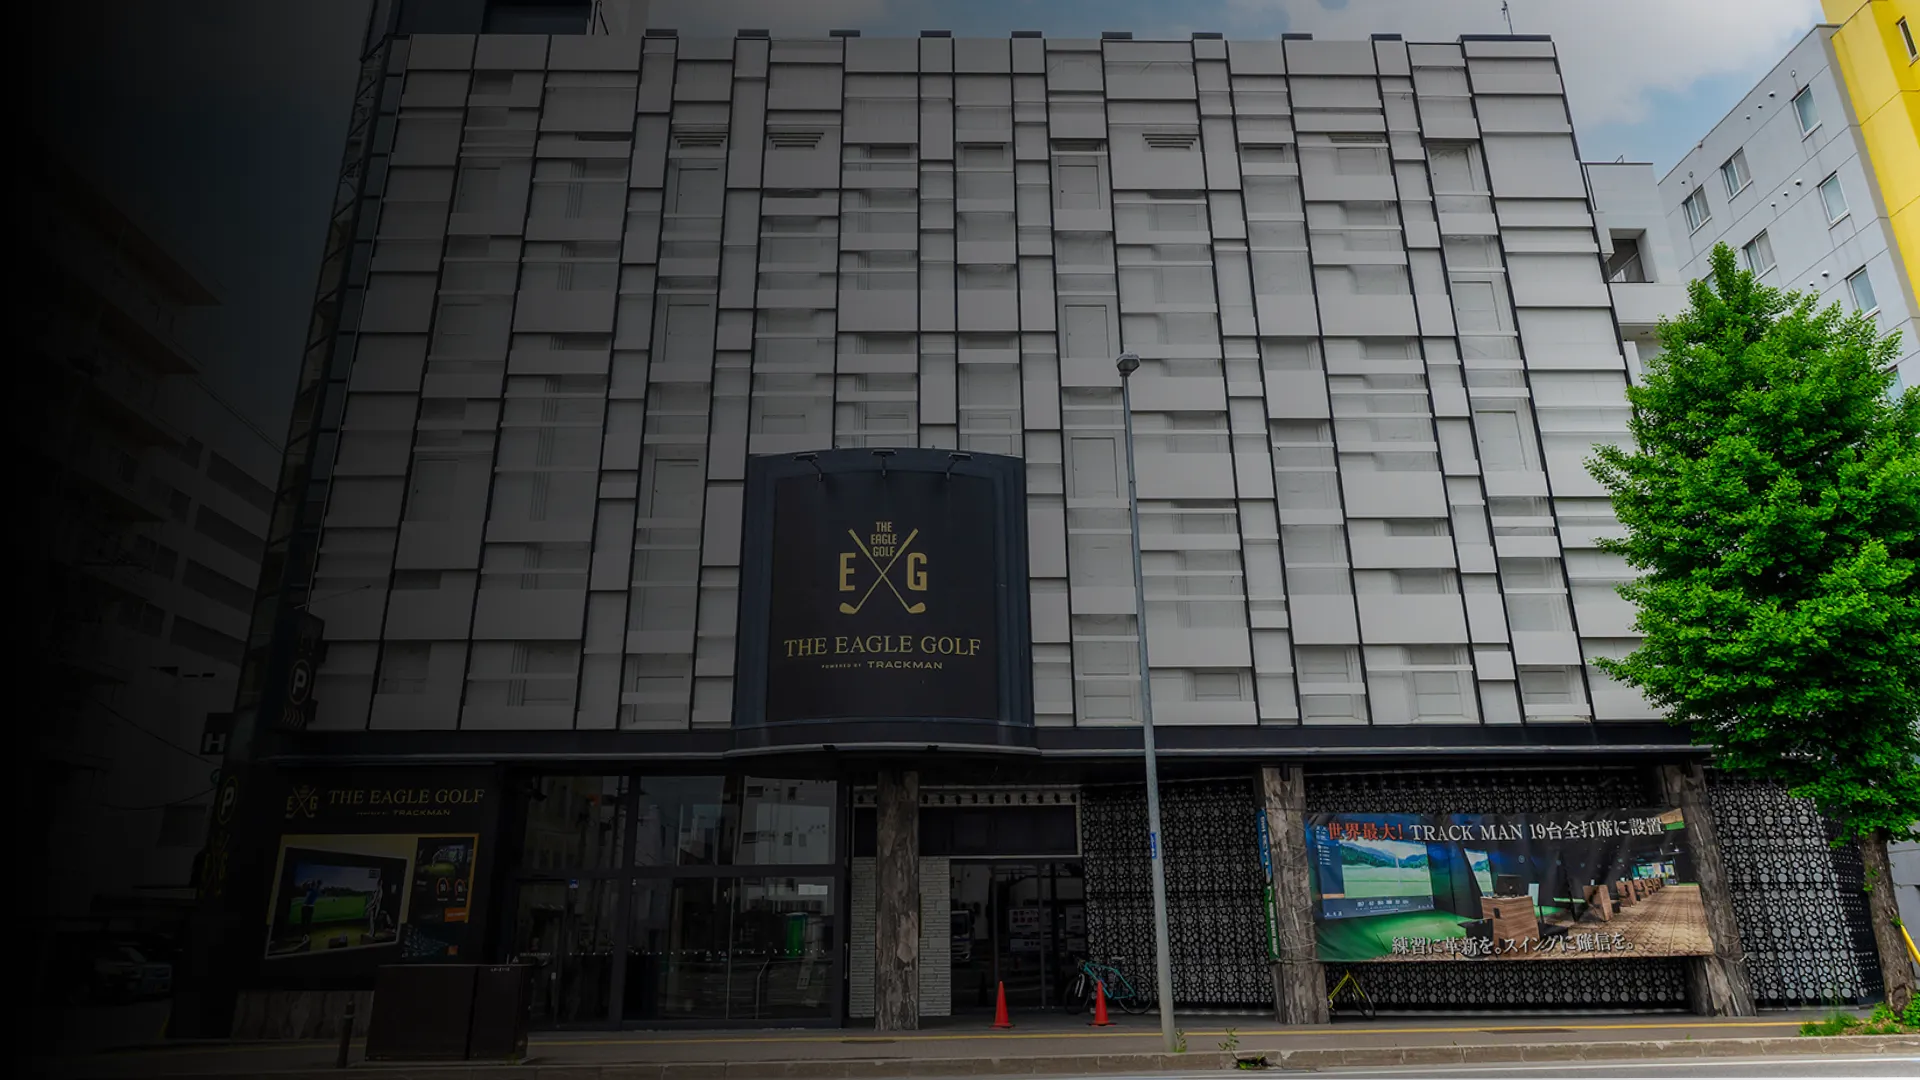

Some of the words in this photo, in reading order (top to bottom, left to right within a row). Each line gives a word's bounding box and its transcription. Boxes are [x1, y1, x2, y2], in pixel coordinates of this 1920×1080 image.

[875, 521, 893, 533] THE
[870, 533, 898, 545] EAGLE
[873, 545, 895, 558] GOLF
[839, 552, 856, 592] E
[907, 552, 928, 591] G
[784, 637, 828, 658] THE
[834, 635, 913, 654] EAGLE
[920, 636, 981, 657] GOLF
[867, 660, 943, 670] TRACKMAN
[292, 668, 307, 695] P
[204, 732, 227, 753] H
[221, 786, 235, 816] P
[328, 789, 365, 805] THE
[369, 788, 430, 805] EAGLE
[435, 788, 486, 804] GOLF
[1409, 824, 1474, 841] TRACK
[1480, 823, 1523, 841] MAN
[1530, 818, 1664, 841] 19台全打席に設置
